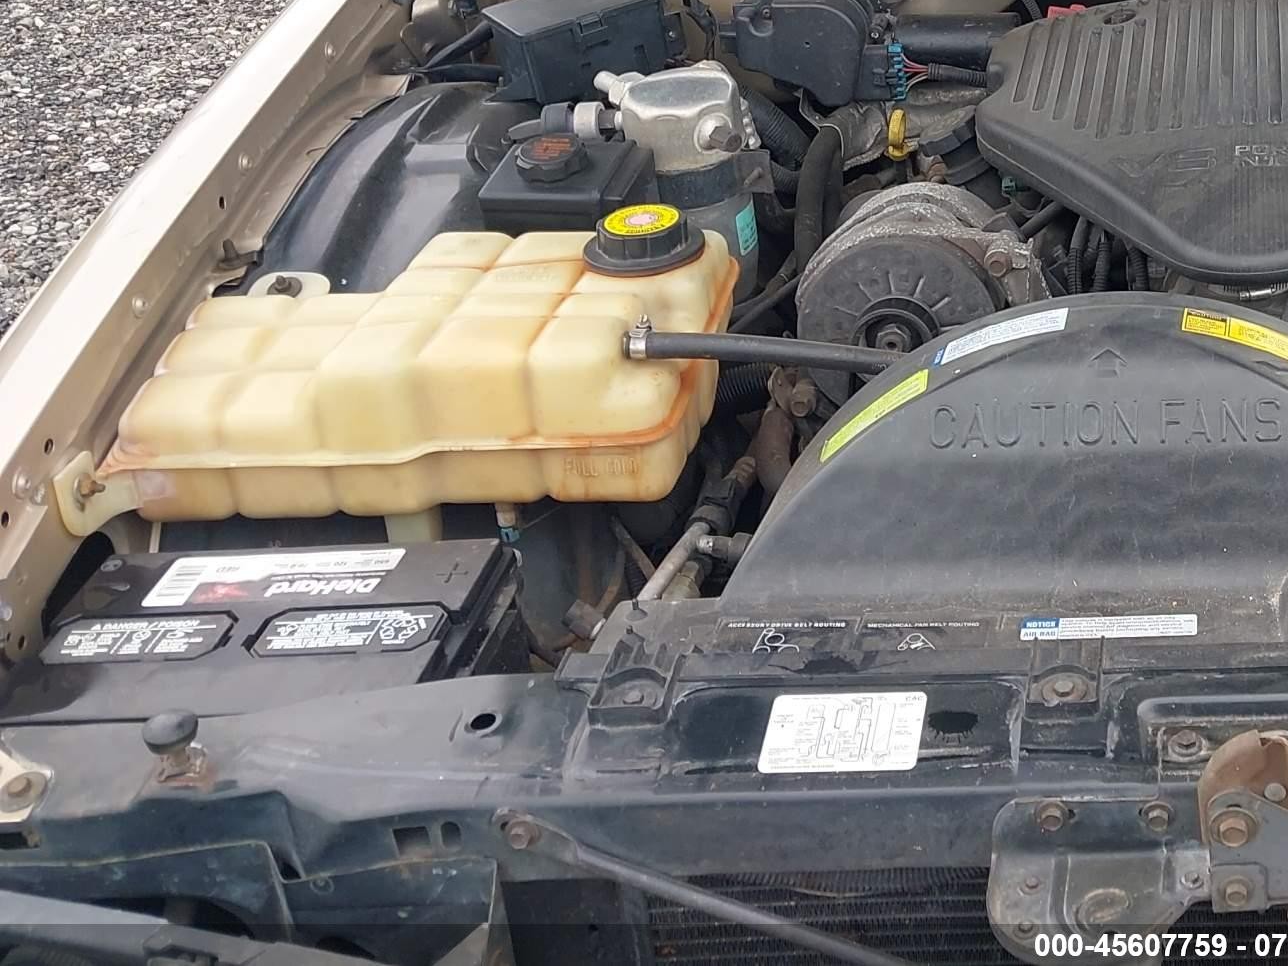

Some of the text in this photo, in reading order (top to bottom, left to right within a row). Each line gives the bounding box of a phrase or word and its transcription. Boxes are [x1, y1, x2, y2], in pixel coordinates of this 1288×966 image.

[929, 400, 1138, 449] CAUTION
[1159, 398, 1283, 444] FANS
[263, 576, 382, 598] DieHard
